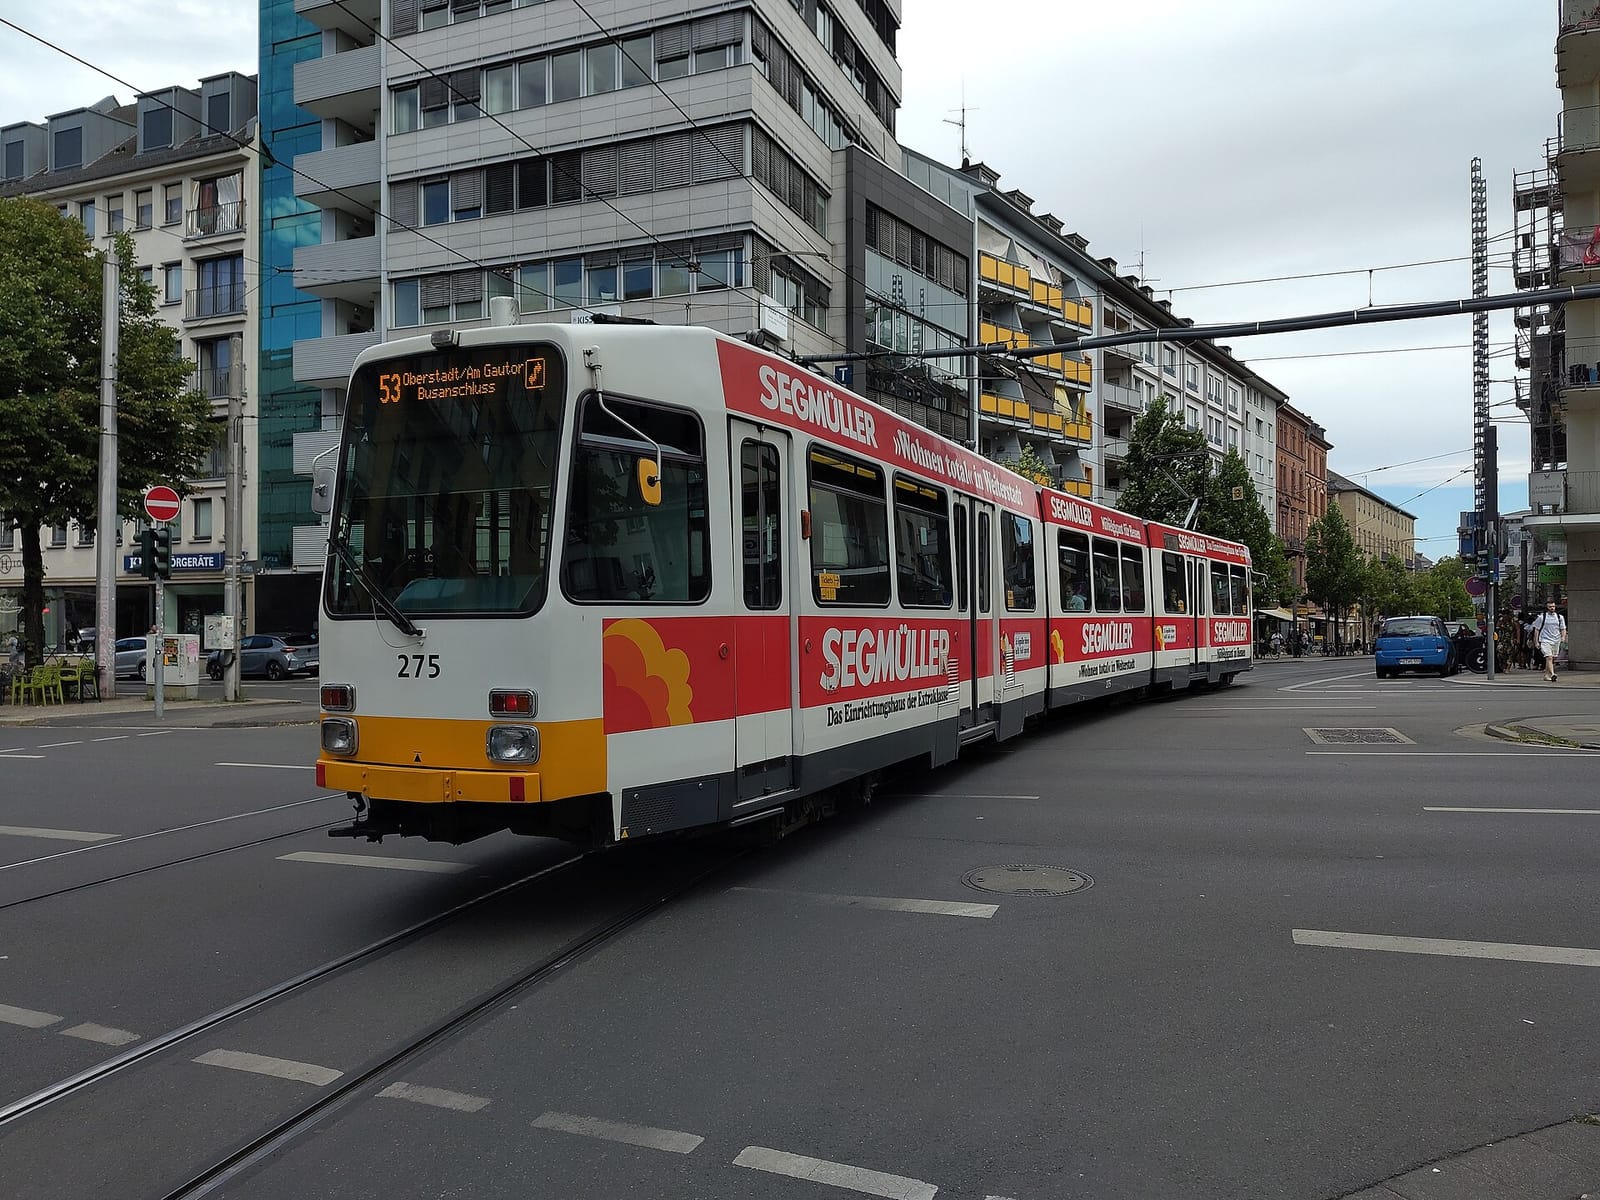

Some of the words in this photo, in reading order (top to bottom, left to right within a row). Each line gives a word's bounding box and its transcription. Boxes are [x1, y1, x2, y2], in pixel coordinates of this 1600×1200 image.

[379, 374, 401, 403] 53
[402, 365, 481, 386] Oberstadt/Am
[483, 361, 524, 378] Gautor
[417, 382, 496, 400] Busanschluss
[758, 364, 878, 448] SEGMÜLLER
[973, 465, 984, 490] in
[982, 468, 1024, 506] Weiterstadt
[1050, 496, 1094, 528] SEGMÜLLER
[1178, 533, 1207, 554] SEGMÜLLER
[171, 555, 214, 568] ÖRGERÄTE
[1081, 620, 1134, 655] SEGMÜLLER
[1214, 620, 1248, 643] SEGMÜLLER
[397, 654, 441, 679] 275
[820, 623, 950, 691] SEGMÜLLER
[827, 706, 843, 727] Das
[844, 696, 906, 722] Einrichtungshaus
[907, 693, 917, 710] der
[917, 688, 949, 708] Extraklasse
